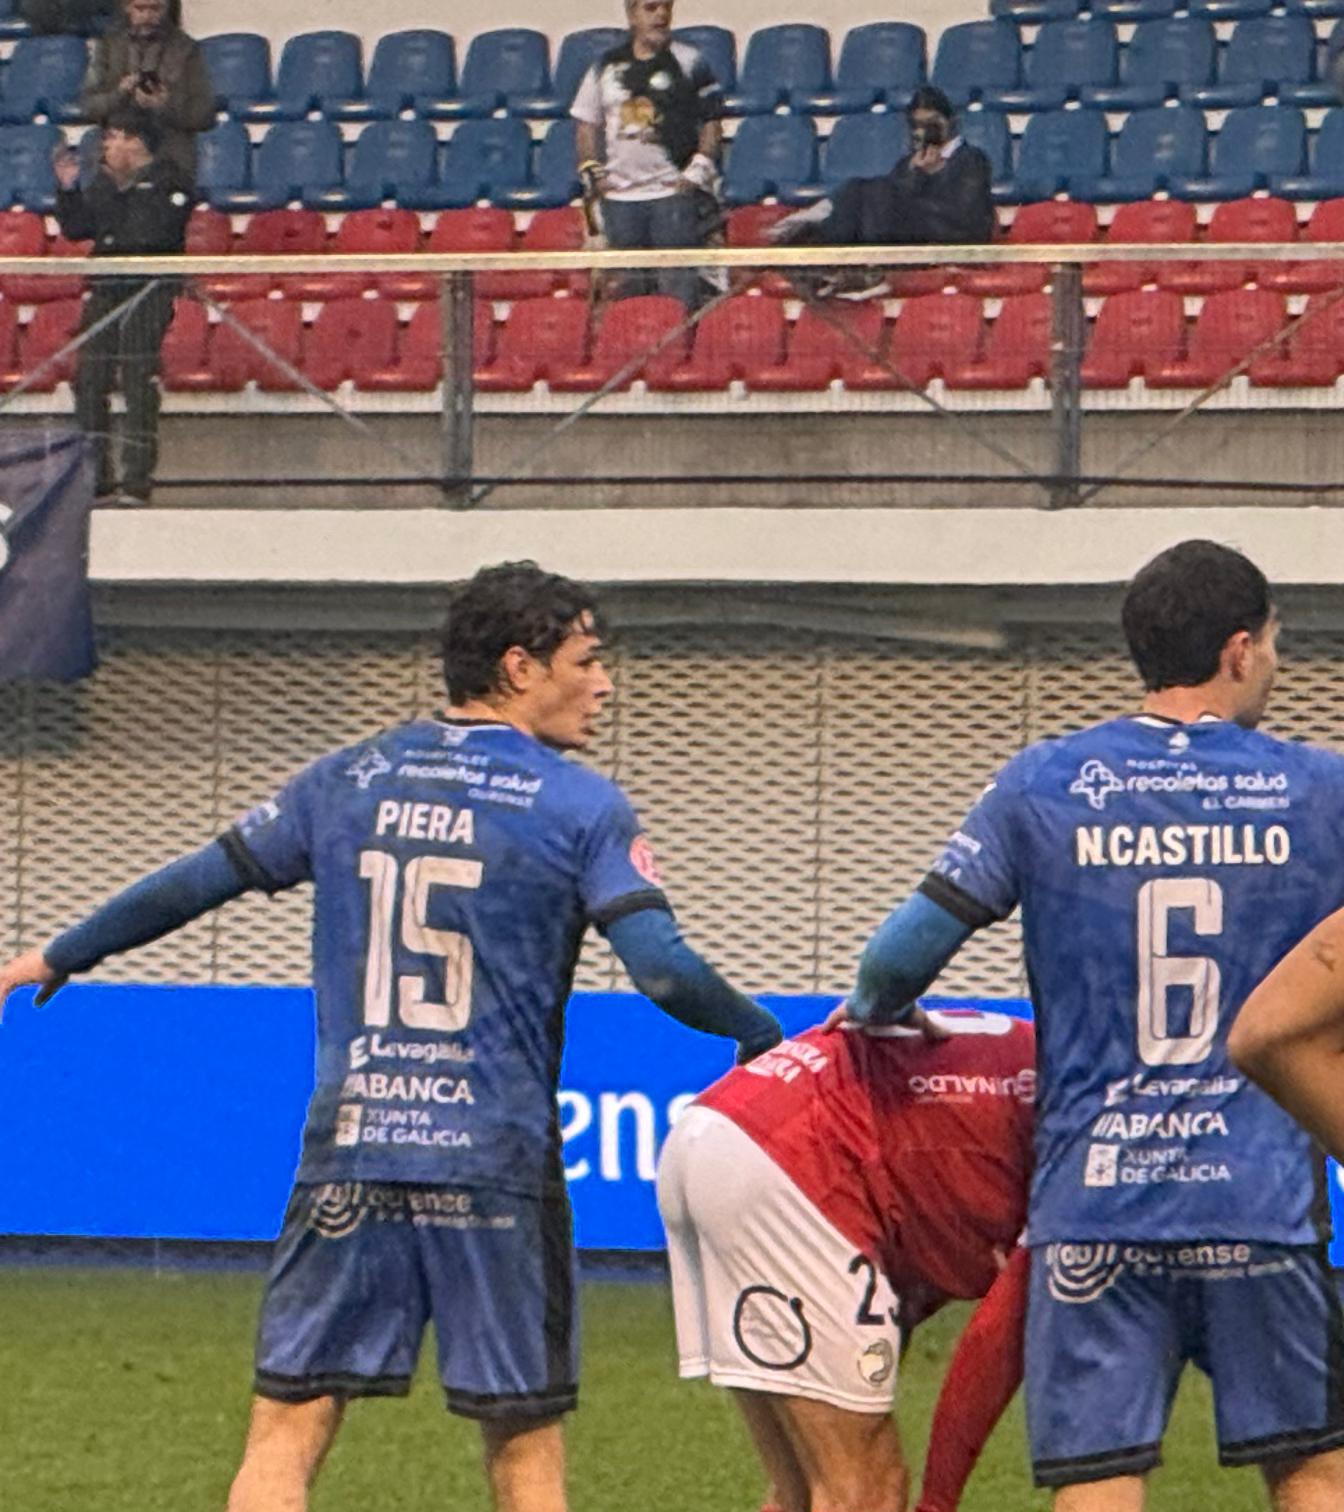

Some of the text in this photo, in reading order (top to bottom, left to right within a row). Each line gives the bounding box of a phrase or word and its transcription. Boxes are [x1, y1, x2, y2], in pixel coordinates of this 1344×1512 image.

[1234, 770, 1288, 791] salud
[376, 800, 475, 844] PIERA
[1076, 824, 1290, 866] N.CASTILLO
[359, 849, 483, 1032] 15
[1136, 876, 1224, 1067] 6
[340, 1073, 475, 1105] ABANCA
[366, 1107, 431, 1126] XUNTA
[1092, 1111, 1230, 1140] ABANCA
[362, 1126, 473, 1148] DE GALICIA
[1120, 1164, 1233, 1184] DE GALICIA
[848, 1253, 898, 1327] 2
